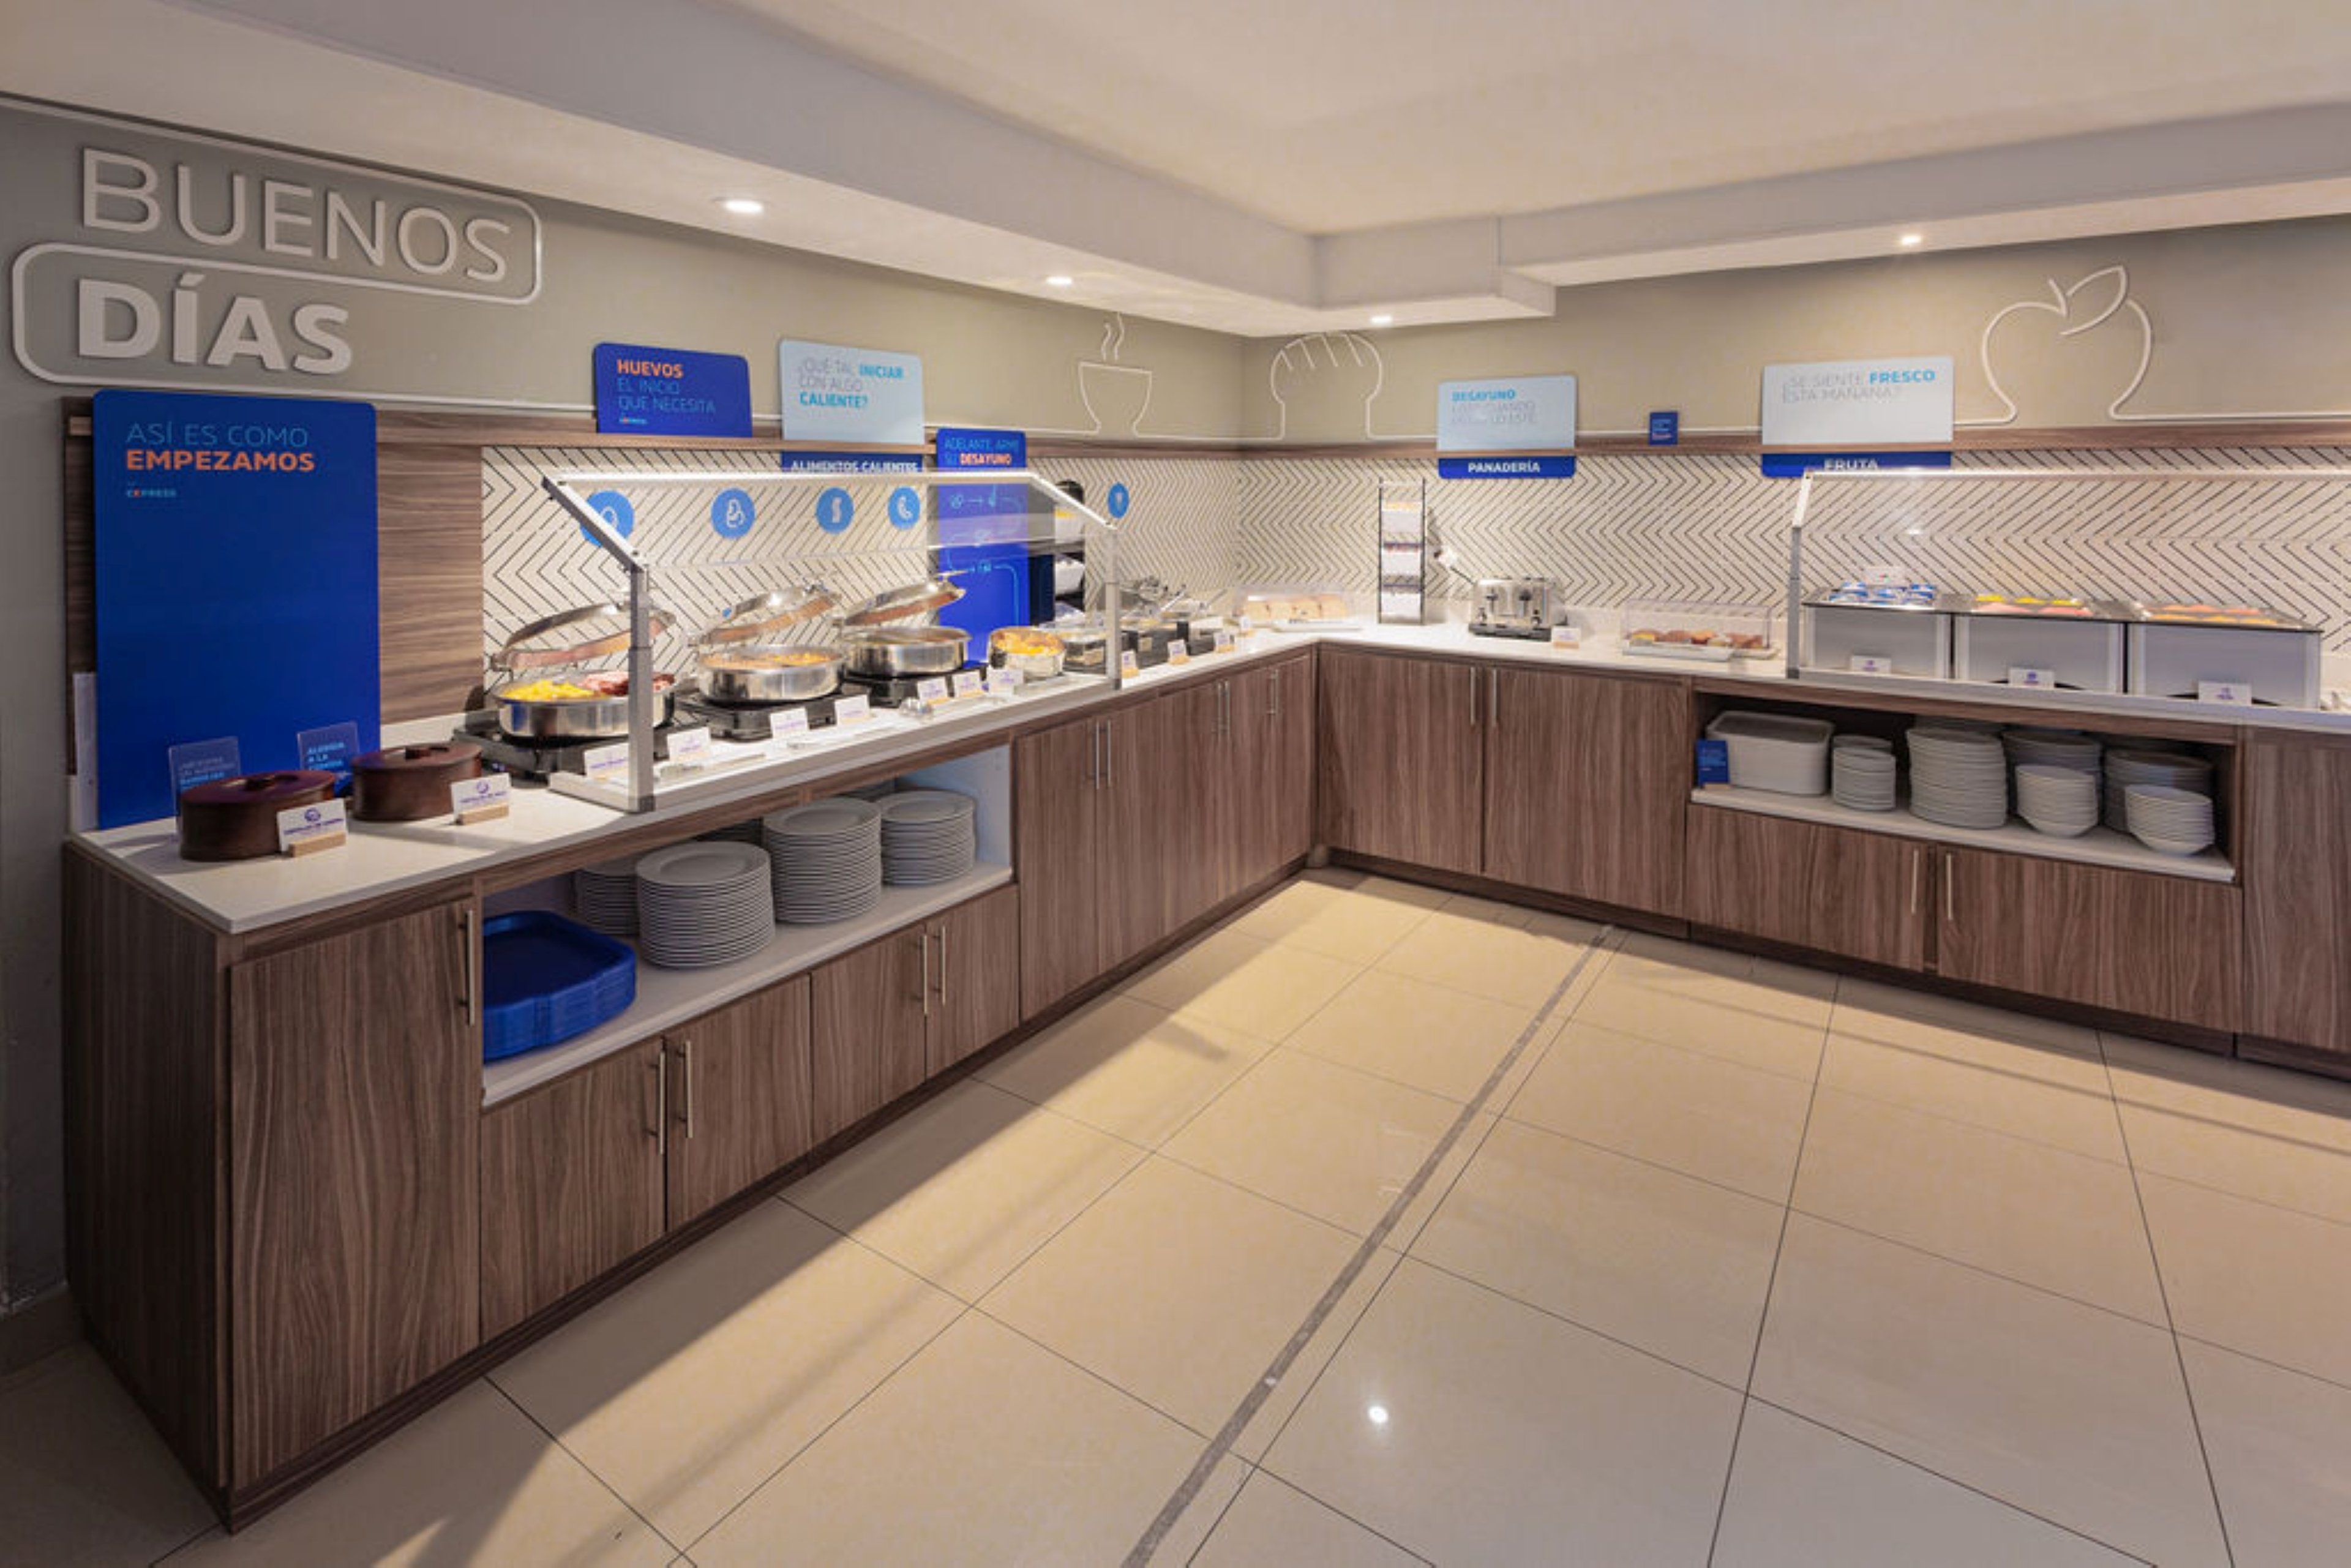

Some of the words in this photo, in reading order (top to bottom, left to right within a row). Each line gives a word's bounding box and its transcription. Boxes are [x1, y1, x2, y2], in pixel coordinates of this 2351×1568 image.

[82, 147, 512, 283] BUENOS
[78, 272, 354, 375] DÍAS
[617, 359, 684, 378] HUEVOS
[859, 364, 904, 379] INICIAR
[1869, 369, 1936, 384] FRESCO
[618, 378, 632, 392] EL
[799, 391, 868, 408] CALIENTE?
[1452, 389, 1516, 402] DESAYUNO
[618, 396, 646, 411] QUE
[653, 398, 716, 415] NECESITA
[126, 422, 173, 446] ASÍ
[184, 425, 217, 446] ES
[228, 426, 309, 448] COMO
[126, 450, 316, 471] EMPEZAMOS
[960, 452, 1011, 465] DESAYUNO
[1824, 459, 1879, 471] FRUTA
[791, 460, 858, 473] ALIMENTOS
[861, 462, 918, 475] CALIENTES
[1468, 460, 1541, 473] PANADERÍA
